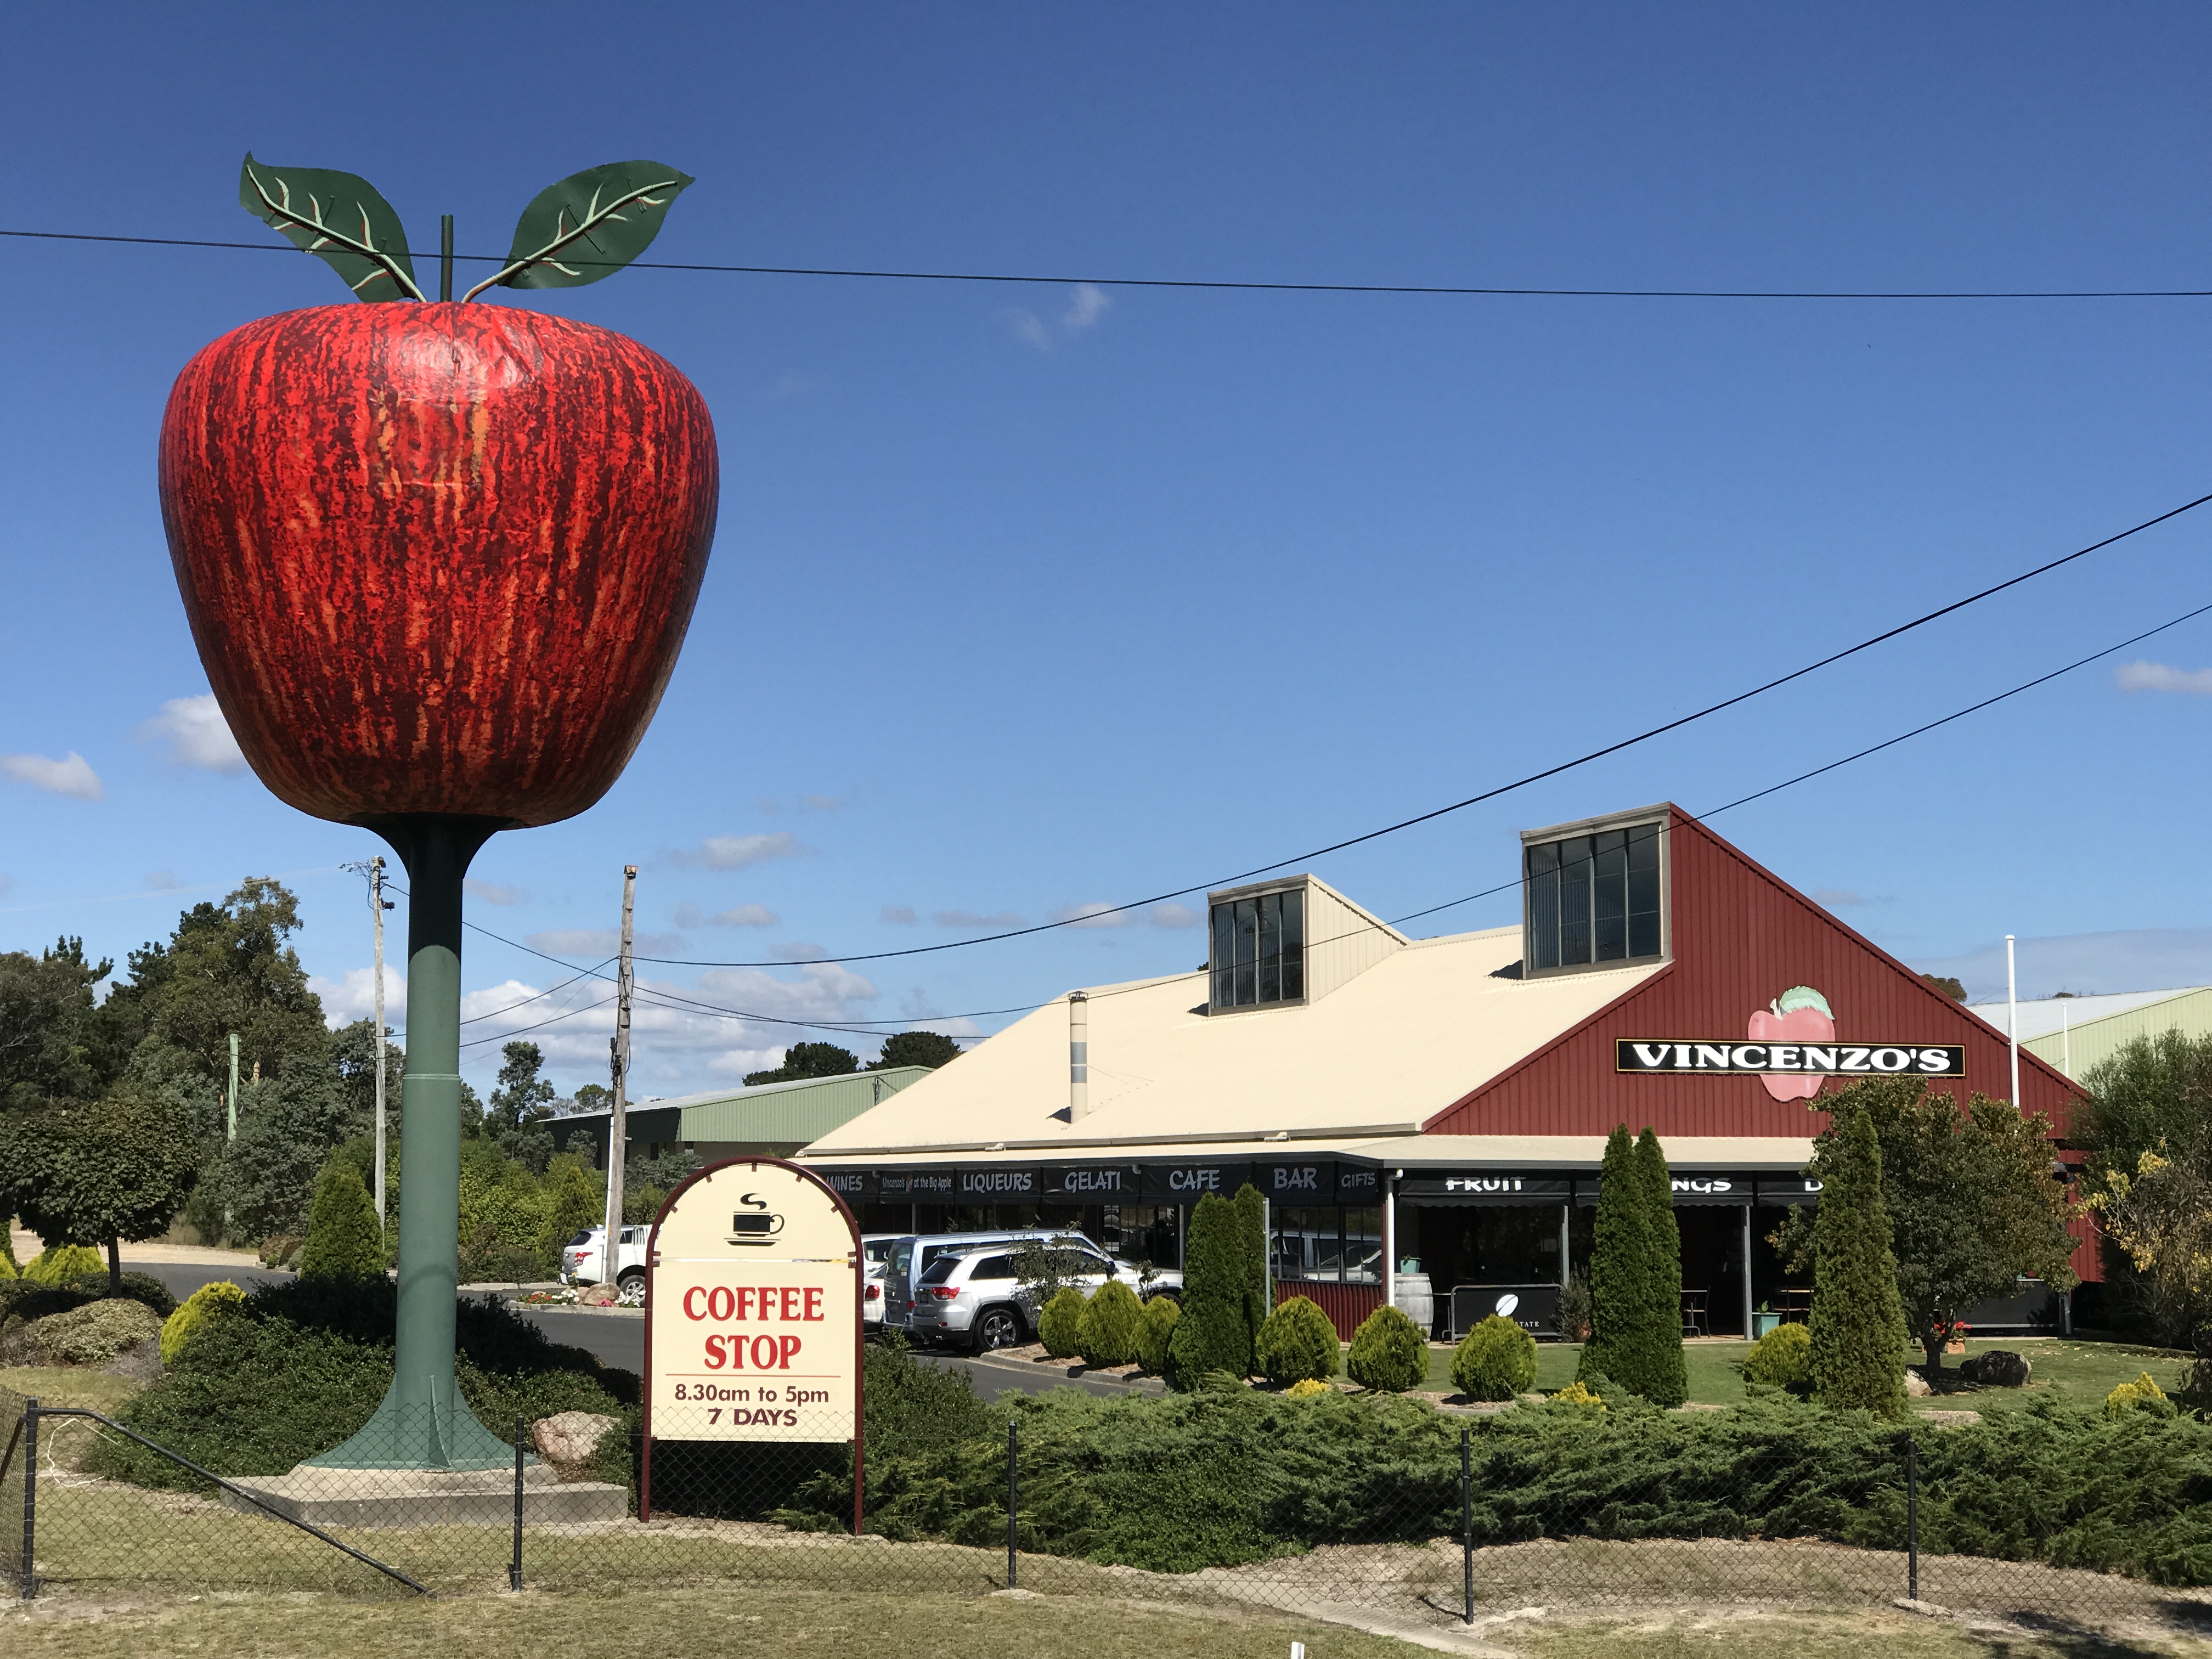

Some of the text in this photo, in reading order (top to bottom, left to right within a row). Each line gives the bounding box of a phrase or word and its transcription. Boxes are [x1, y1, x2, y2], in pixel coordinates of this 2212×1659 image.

[1633, 1044, 1950, 1071] VINCENZO'S
[827, 1176, 862, 1191] WINES
[882, 1176, 905, 1188] Vincenzo's
[914, 1178, 919, 1188] at
[920, 1177, 928, 1188] the
[938, 1176, 952, 1191] Apple
[963, 1173, 1032, 1193] LIQUEURS
[1065, 1171, 1120, 1193] GELATI
[1170, 1170, 1220, 1189] CAFE
[1274, 1167, 1317, 1190] BAR
[1341, 1172, 1375, 1188] GIFTS
[1446, 1176, 1526, 1192] FRUIT
[683, 1286, 825, 1321] COFFEE
[704, 1334, 802, 1370] STOP
[675, 1384, 829, 1407] 8.30am to 5pm
[708, 1408, 798, 1426] 7 DAYS
